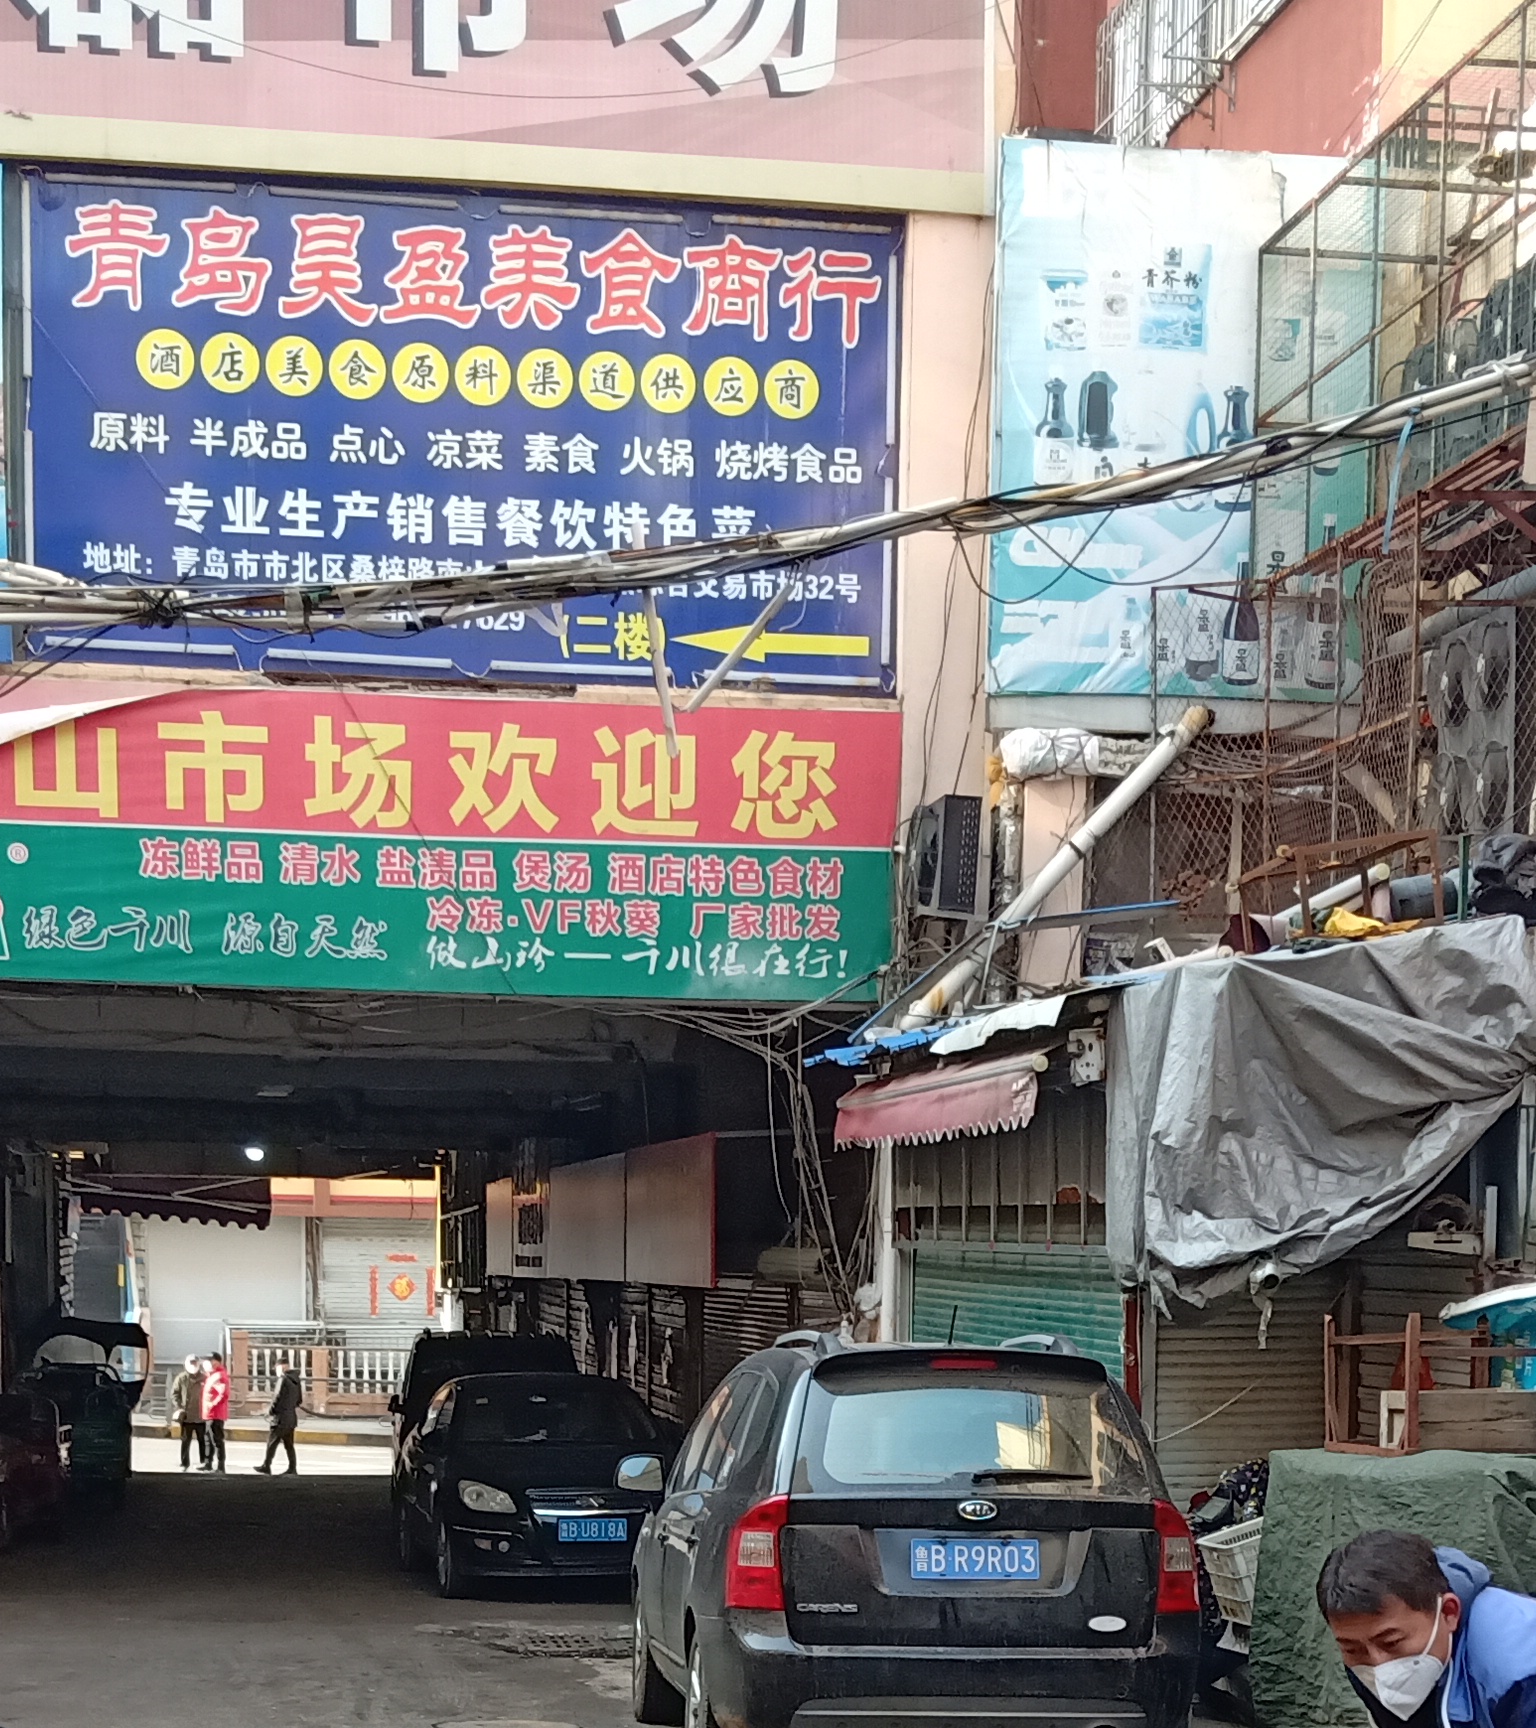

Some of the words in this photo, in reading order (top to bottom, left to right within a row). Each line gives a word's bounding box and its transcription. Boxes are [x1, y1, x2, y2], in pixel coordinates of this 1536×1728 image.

[65, 199, 881, 348] 青岛昊盈美食商行
[144, 337, 813, 415] 酒店美食原料渠道供应商
[89, 412, 170, 455] 原料
[190, 417, 308, 461] 半成品
[329, 423, 406, 466] 点心
[426, 429, 505, 472] 凉菜
[523, 432, 600, 476] 素食
[619, 436, 695, 478] 火锅
[714, 439, 864, 485] 烧烤食品
[138, 836, 263, 884] 冻鲜品
[279, 841, 362, 886] 清水
[375, 845, 498, 893] 盐渍品
[511, 850, 592, 894] 煲汤
[607, 852, 845, 900] 酒店特色食材
[688, 902, 842, 943] 厂家批发
[962, 1502, 994, 1517] KIA
[796, 1602, 859, 1614] CARENS
